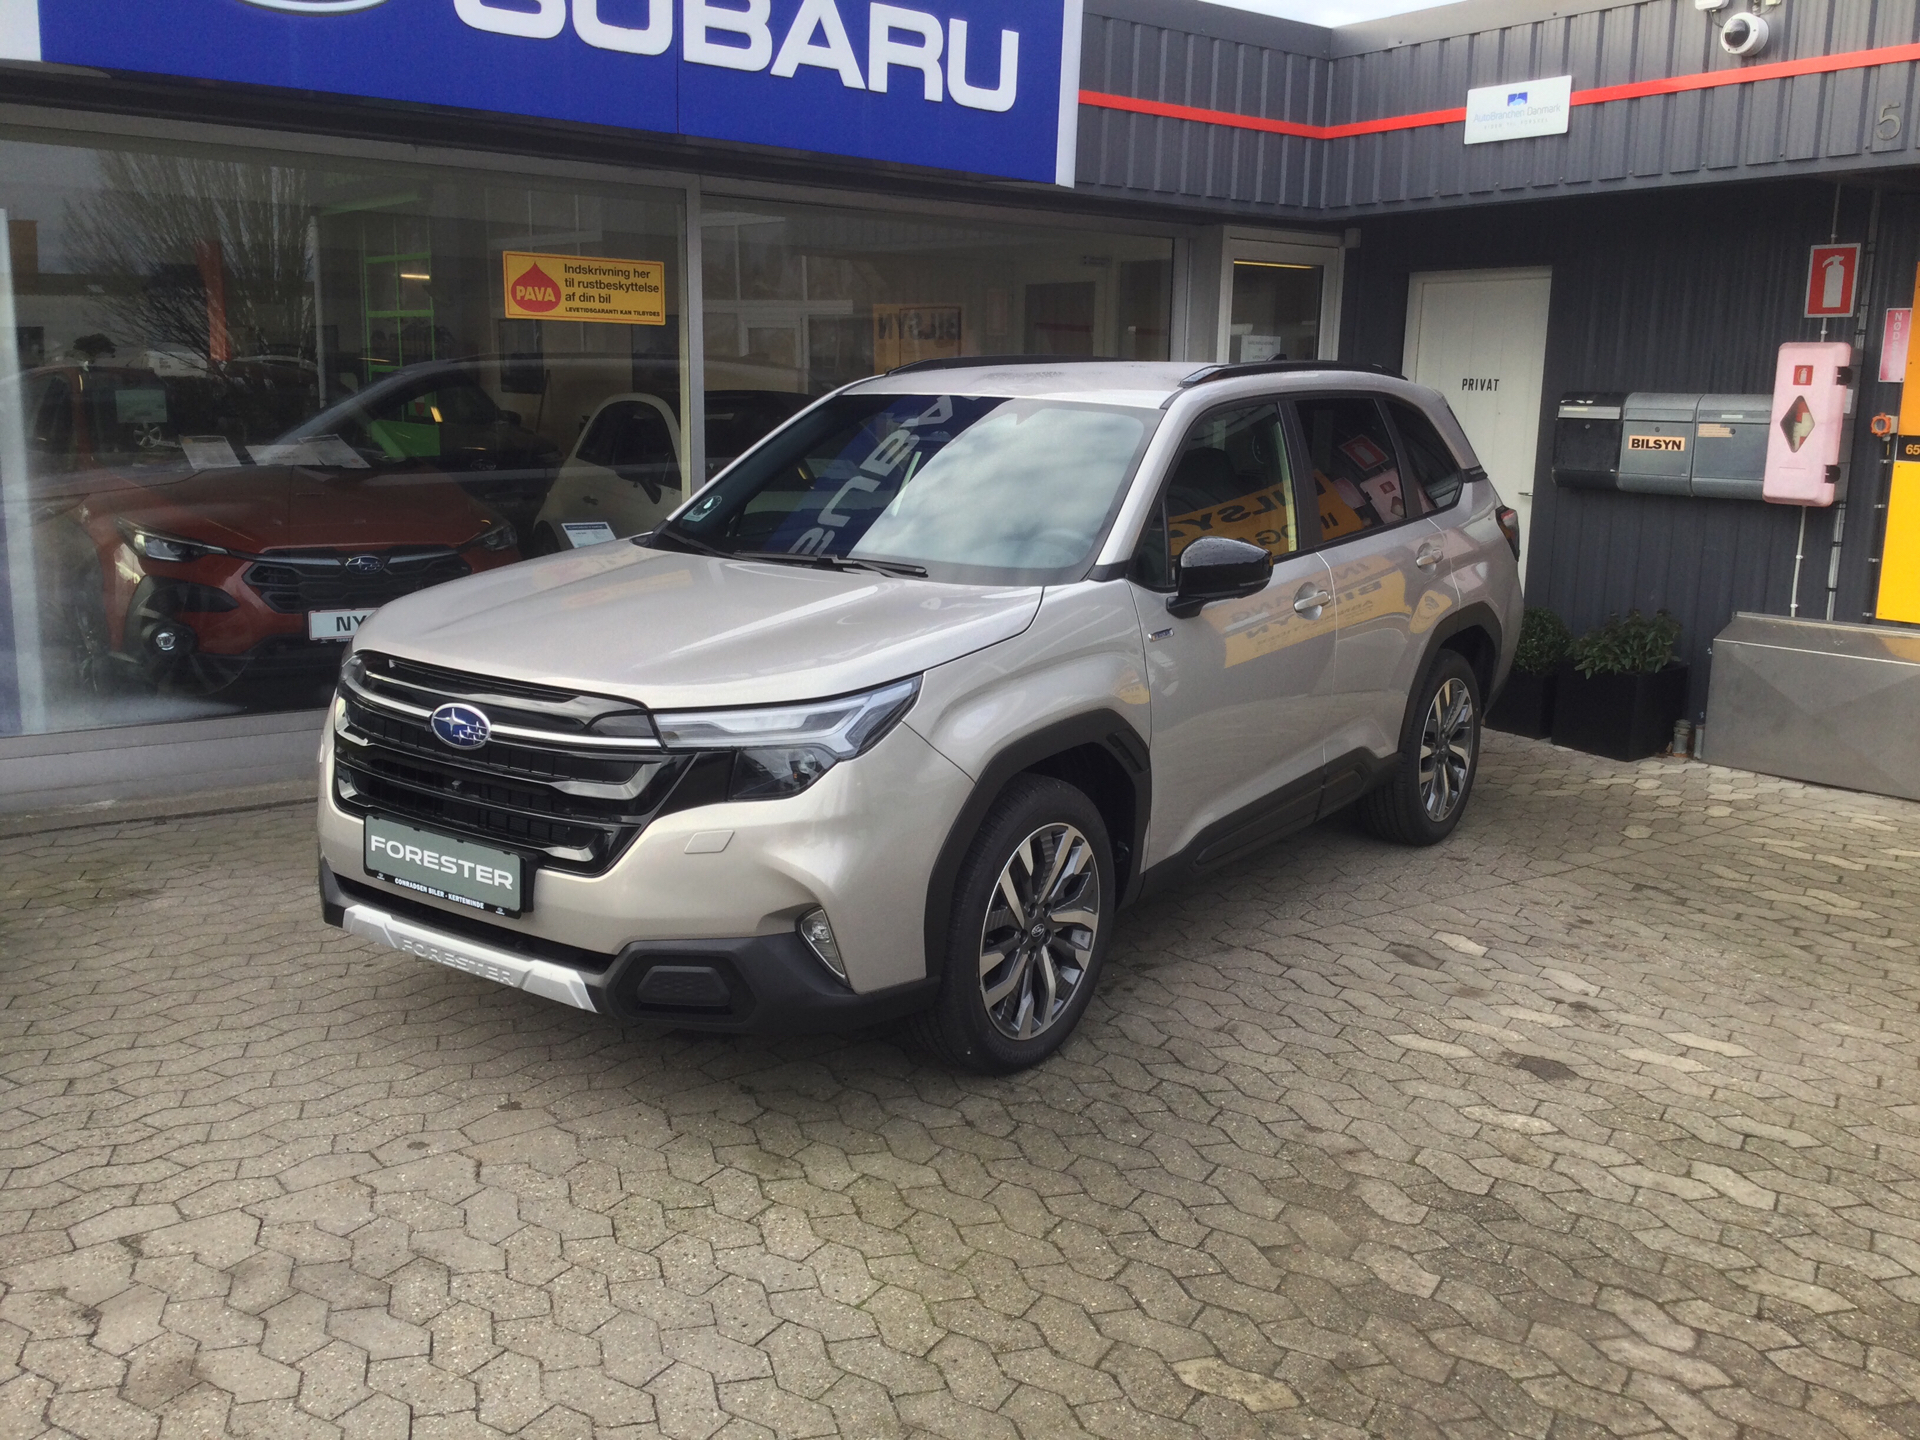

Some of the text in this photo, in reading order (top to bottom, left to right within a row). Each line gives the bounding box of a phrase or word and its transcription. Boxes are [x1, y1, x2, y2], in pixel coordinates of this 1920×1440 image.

[1527, 104, 1561, 116] Danmark
[1876, 102, 1902, 141] 5
[564, 263, 650, 280] Indskrivning her
[564, 278, 660, 293] til rustbeskyttelse
[516, 286, 556, 302] PAVA
[565, 292, 611, 304] af din bil
[565, 306, 619, 315] LEVETIDSGARANTI
[1462, 378, 1500, 391] PRIVAT
[1631, 438, 1682, 451] BILSYN
[1905, 444, 1920, 455] 65
[370, 835, 513, 890] FORESTER
[394, 877, 485, 909] CONRADSEN BILER KERTEMINDE
[402, 939, 514, 985] FORESTER
